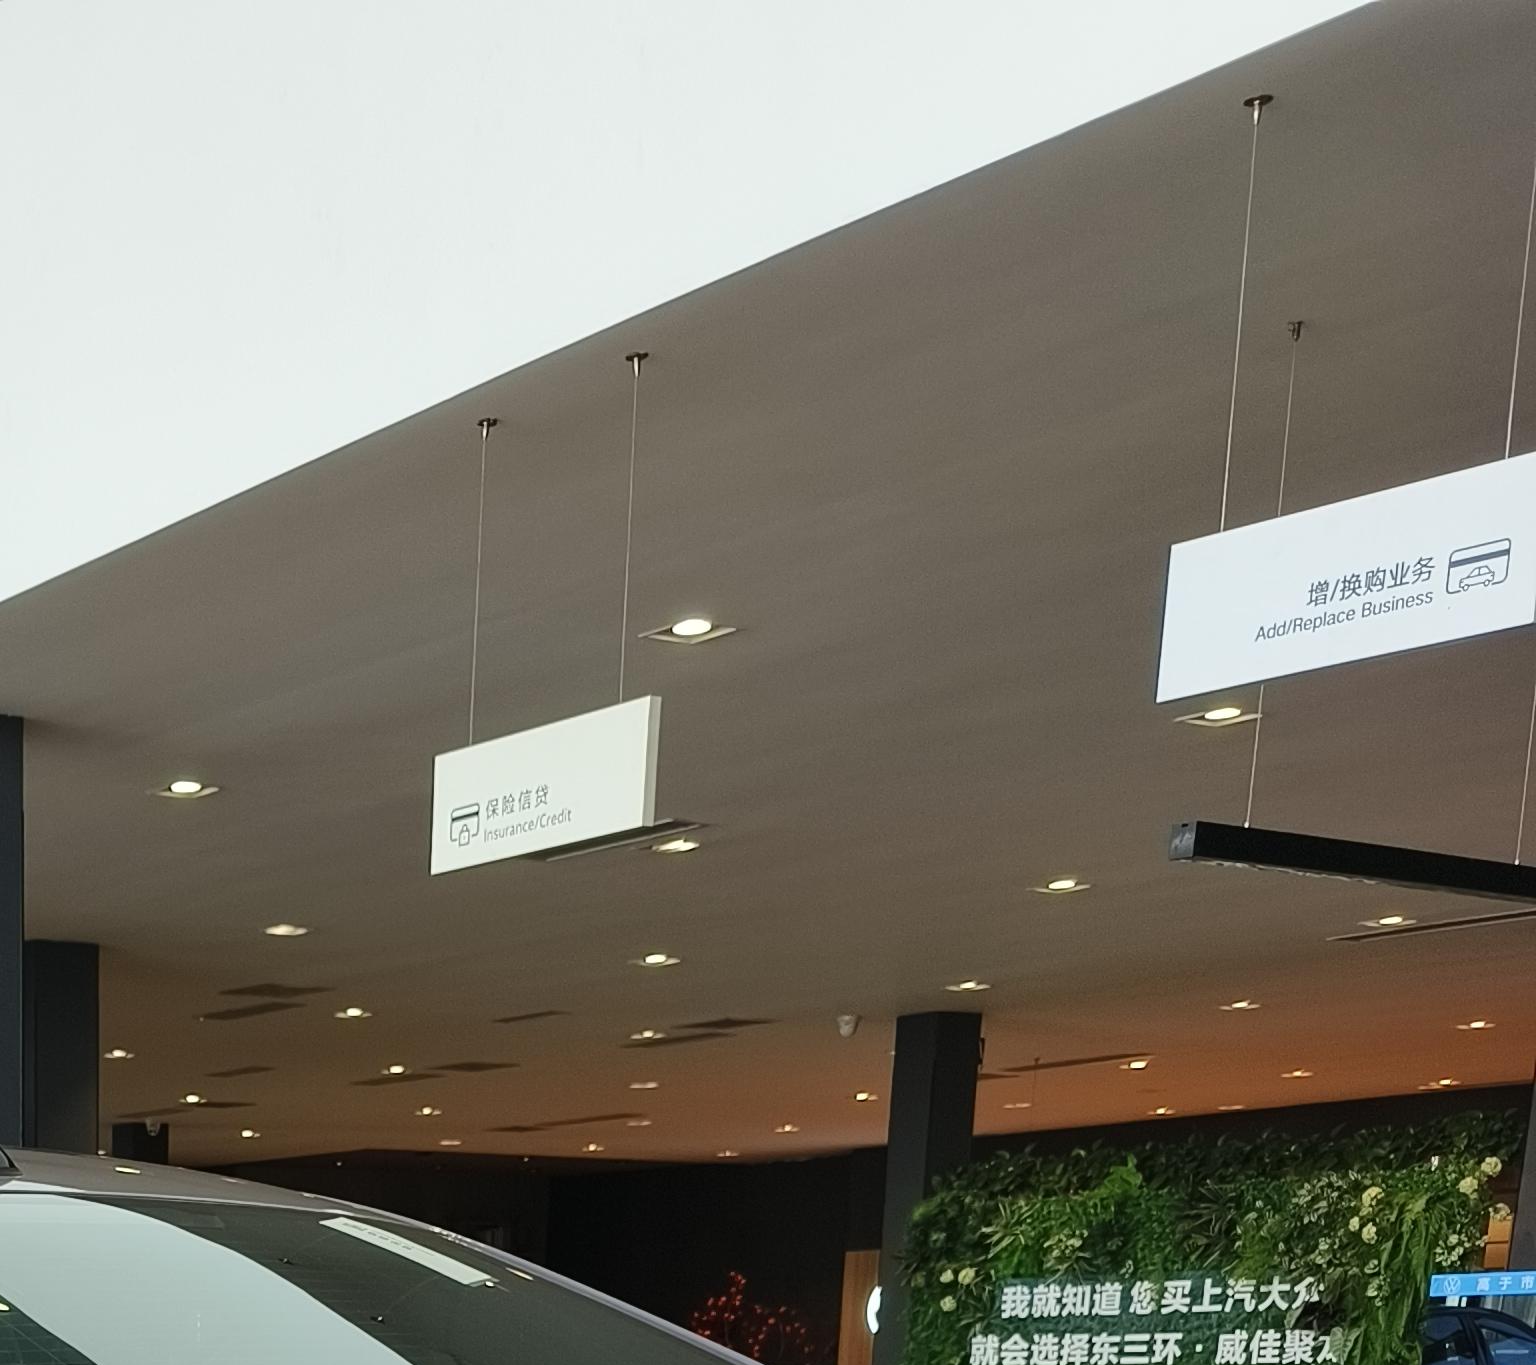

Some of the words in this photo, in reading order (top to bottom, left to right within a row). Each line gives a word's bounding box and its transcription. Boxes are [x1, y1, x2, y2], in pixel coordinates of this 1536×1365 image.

[1305, 556, 1436, 608] 增/换购业务
[1254, 605, 1357, 643] Add/Replace
[1360, 589, 1434, 619] Business
[485, 783, 550, 821] 保险信贷
[483, 806, 572, 844] Insurance/Credit
